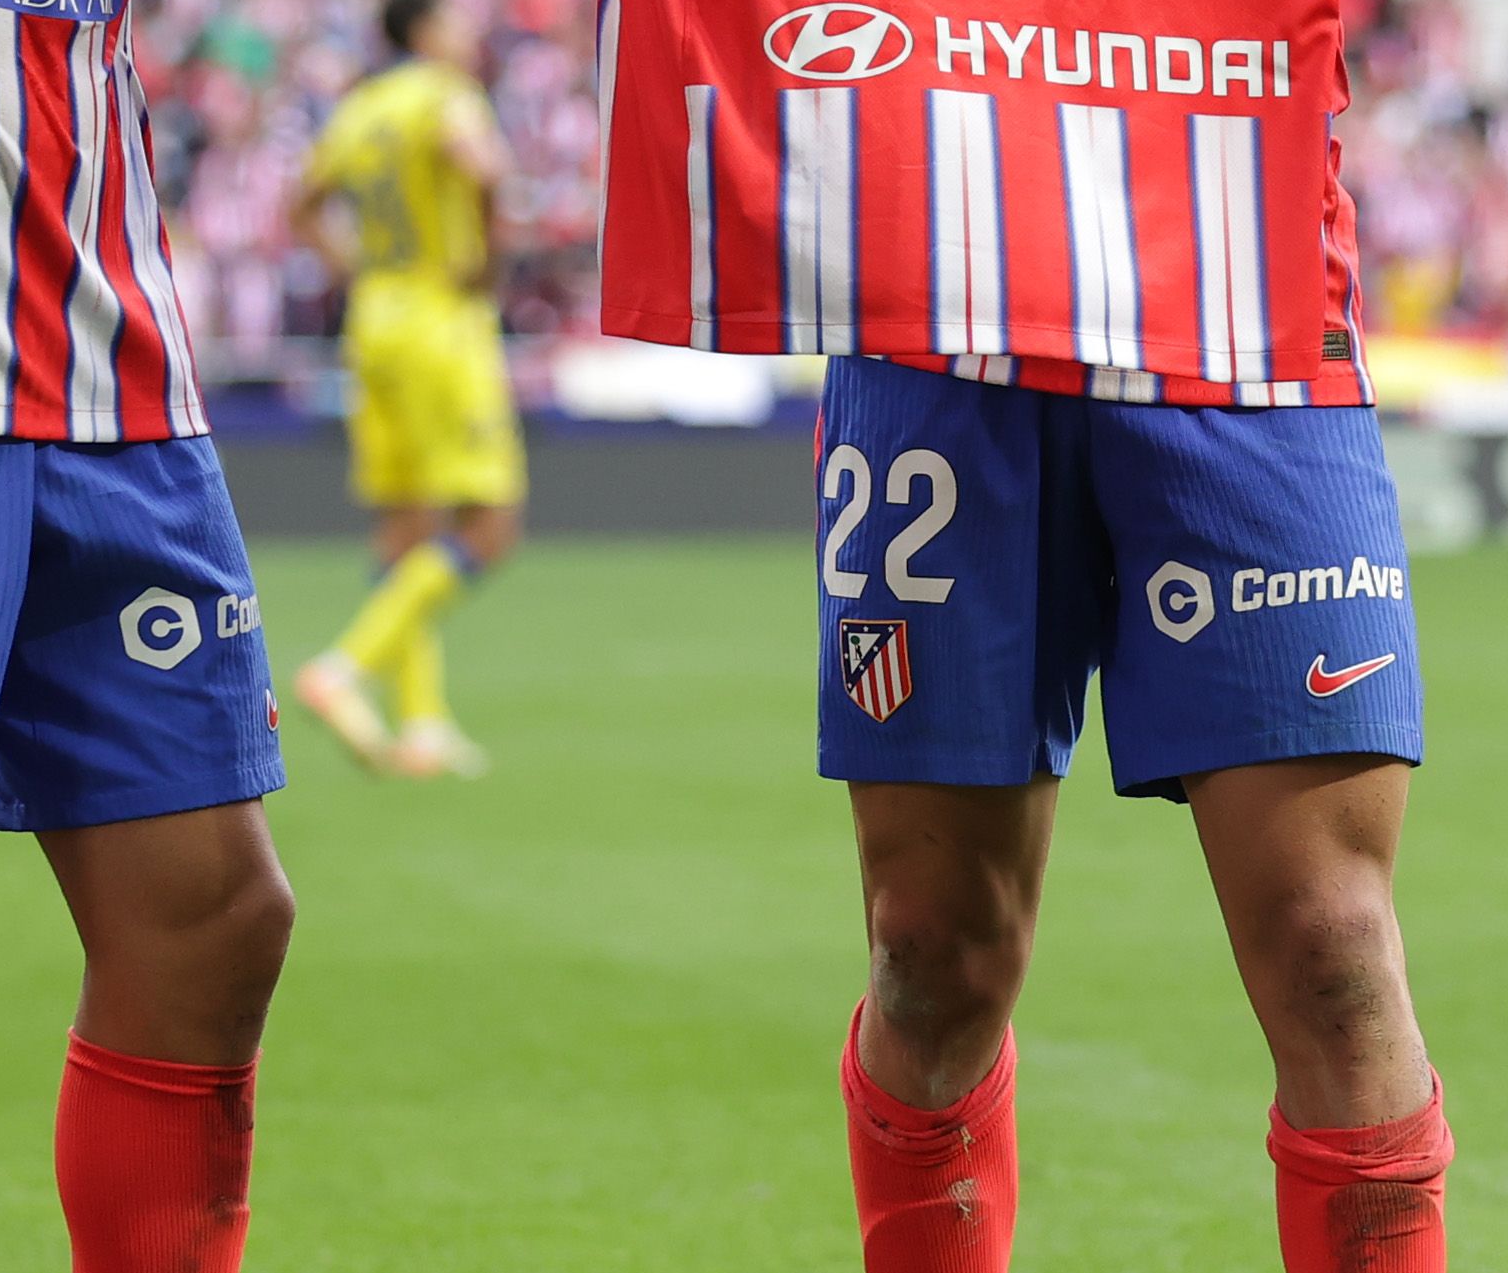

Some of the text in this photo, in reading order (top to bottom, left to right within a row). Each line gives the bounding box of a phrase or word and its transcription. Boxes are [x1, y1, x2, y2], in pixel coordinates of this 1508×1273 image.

[935, 15, 1291, 98] HYUNDAI
[822, 443, 958, 604] 22
[1230, 556, 1405, 614] ComAve
